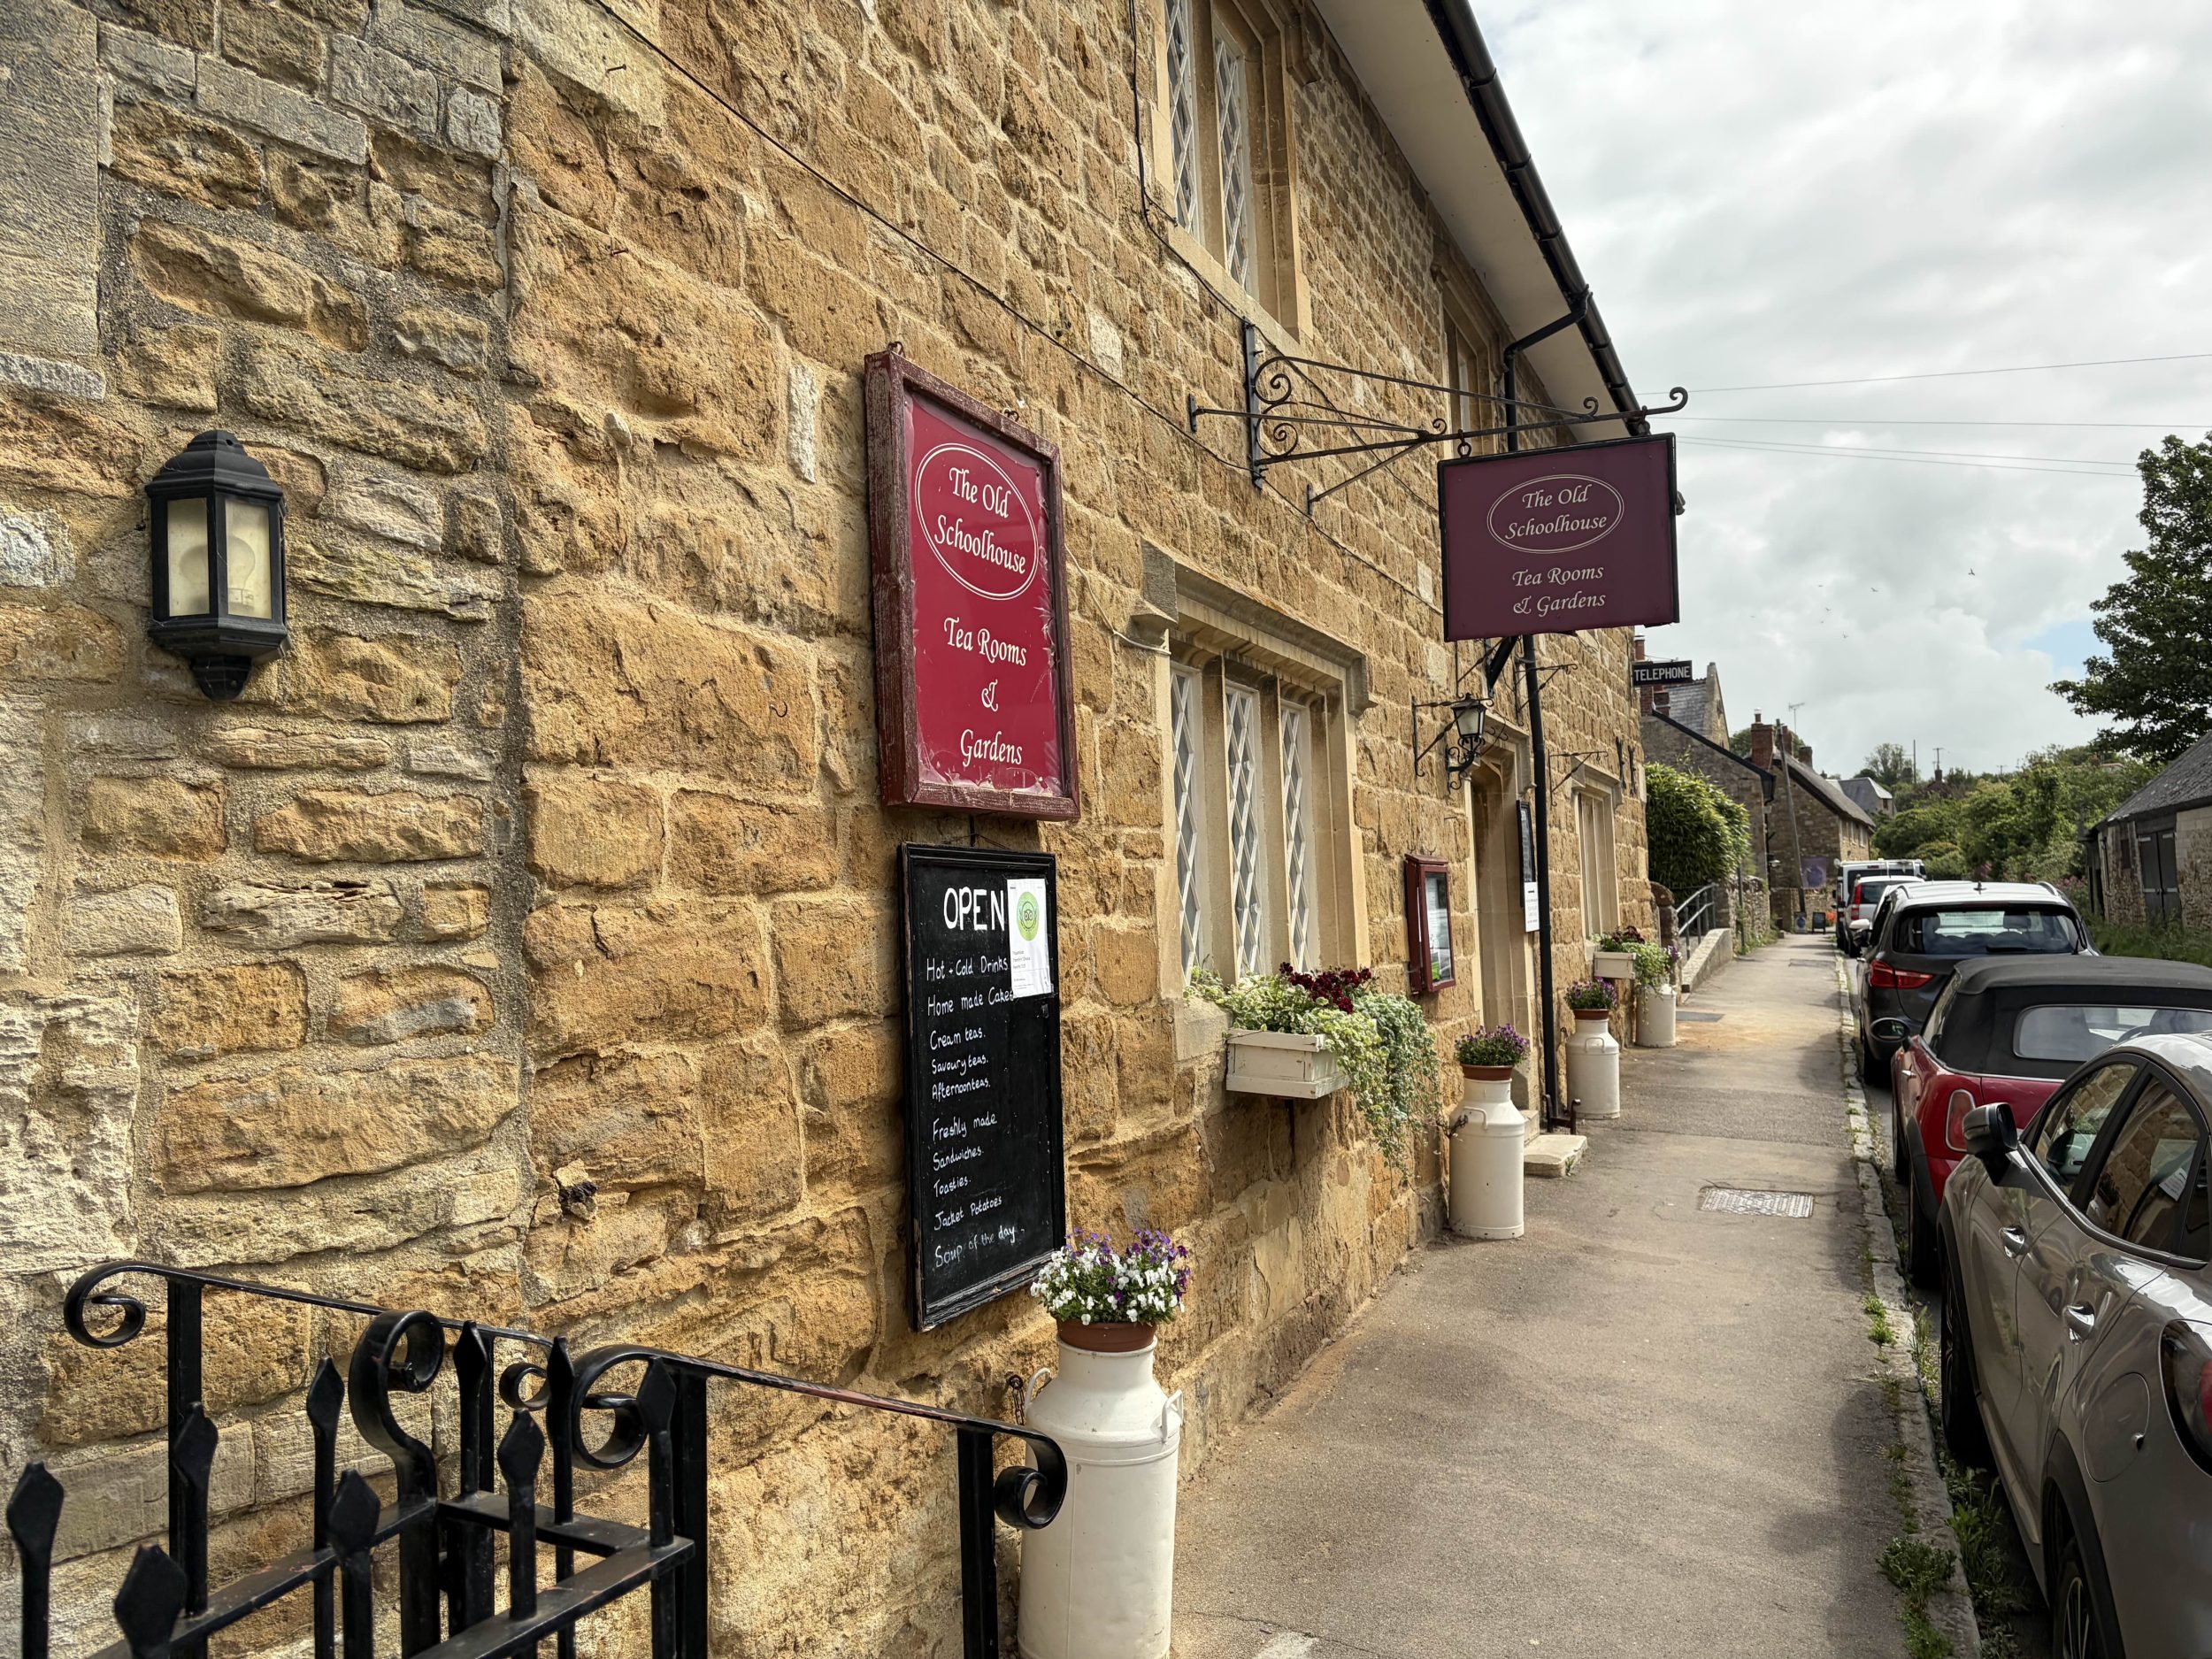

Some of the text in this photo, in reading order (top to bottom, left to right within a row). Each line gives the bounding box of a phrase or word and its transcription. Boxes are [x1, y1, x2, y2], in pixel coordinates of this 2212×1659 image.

[949, 467, 1011, 518] The Old
[1522, 484, 1593, 509] The Old
[1504, 514, 1607, 540] Schoolhouse
[934, 514, 1025, 574] Schoolhouse
[1512, 566, 1604, 587] Tea Rooms
[1513, 590, 1606, 618] & Gardens
[944, 617, 1027, 666] Tea Rooms
[1633, 666, 1691, 681] TELEPHONE
[981, 680, 998, 711] &
[960, 729, 1023, 767] Gardens
[943, 886, 1005, 932] OPEN
[926, 957, 945, 981] Hot
[956, 957, 974, 976] Cold
[980, 955, 1009, 974] Drinks
[927, 994, 955, 1017] Home
[961, 990, 983, 1010] made
[930, 1026, 986, 1050] Cream teas.
[931, 1054, 989, 1076] Savoury teas.
[933, 1111, 997, 1141] Freshly made
[933, 1146, 984, 1171] Sandwiches.
[933, 1175, 972, 1197] Toasties.
[934, 1195, 1002, 1231] Jacket Potatoes
[934, 1245, 963, 1268] Soup
[968, 1234, 978, 1250] of
[980, 1233, 995, 1246] the
[998, 1225, 1015, 1243] day
